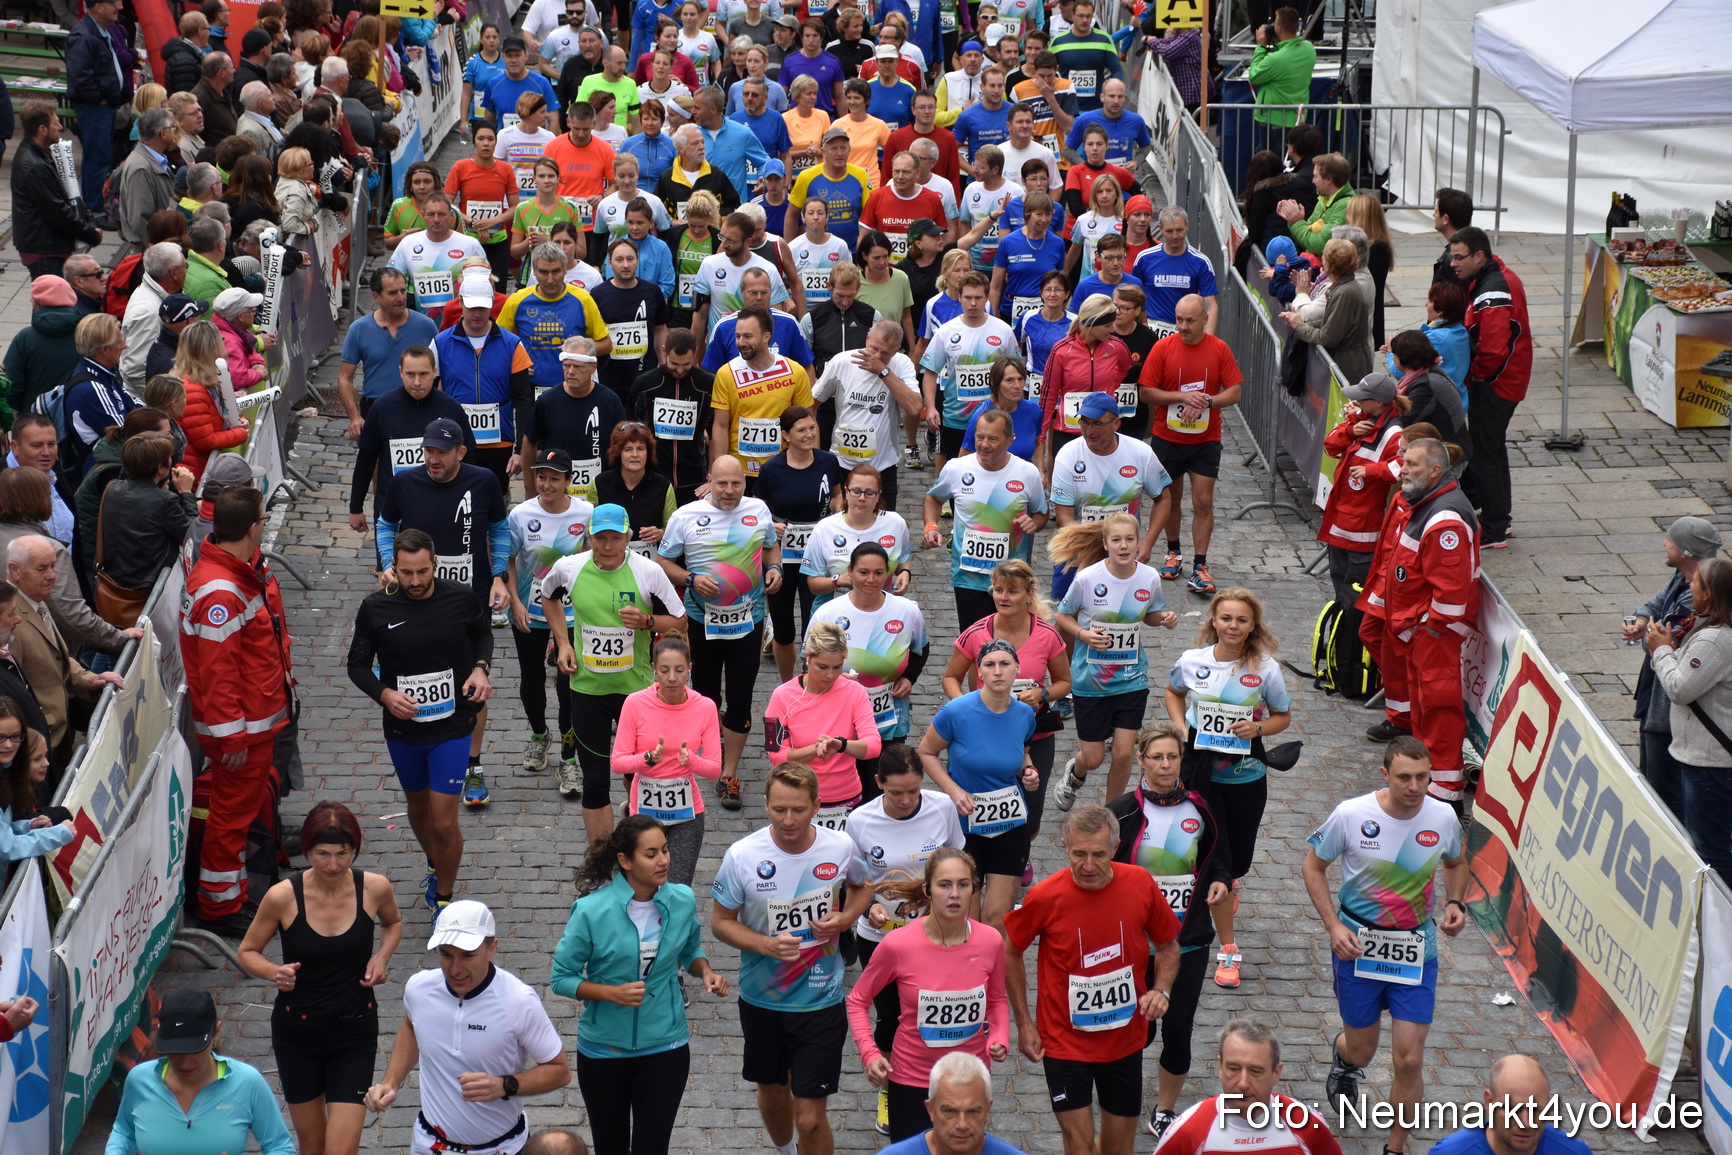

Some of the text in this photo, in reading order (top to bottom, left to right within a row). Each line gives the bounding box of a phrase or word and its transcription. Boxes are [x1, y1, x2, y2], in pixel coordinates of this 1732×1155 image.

[807, 276, 829, 289] 233
[1152, 274, 1191, 284] HUBER
[261, 253, 281, 325] BMW Laufsport
[418, 280, 450, 295] 3105
[616, 331, 642, 346] 276
[738, 378, 796, 400] MAX BÖGL
[657, 408, 694, 426] 2783
[660, 426, 687, 435] Christian
[742, 427, 779, 443] 2719
[842, 433, 868, 448] 232
[848, 449, 864, 458] Georg
[966, 540, 1004, 559] 3050
[582, 629, 599, 637] PARTL
[718, 625, 742, 634] Norbert
[592, 638, 624, 656] 243
[1096, 652, 1129, 660] Franziska
[596, 659, 619, 667] Martin
[417, 675, 445, 685] Neumarkt
[1217, 708, 1245, 716] Neumarkt
[1210, 737, 1235, 747] Denisa
[656, 781, 684, 789] Neumarkt
[642, 788, 687, 808] 2131
[989, 791, 1013, 801] Neumarkt
[655, 811, 676, 820] Luise
[975, 800, 1022, 823] 2282
[981, 821, 1015, 834] Elisabeth
[816, 865, 837, 877] Hervis
[768, 894, 822, 911] PARTL Neumarkt
[776, 901, 829, 931] 2616
[1522, 822, 1661, 1035] PFLASTERSTEINE
[1359, 931, 1414, 943] PARTL Neumarkt
[1094, 950, 1111, 962] DEHN
[1363, 940, 1418, 963] 2455
[1375, 963, 1402, 975] Albert
[1071, 975, 1124, 989] PARTL Neumarkt
[920, 994, 977, 1003] PARTL Neumarkt
[1076, 982, 1131, 1012] 2440
[925, 1001, 981, 1025] 2828
[1093, 1012, 1118, 1024] Franz
[468, 1023, 487, 1031] kalas
[939, 1029, 964, 1039] Elena
[1235, 1135, 1267, 1145] saller
